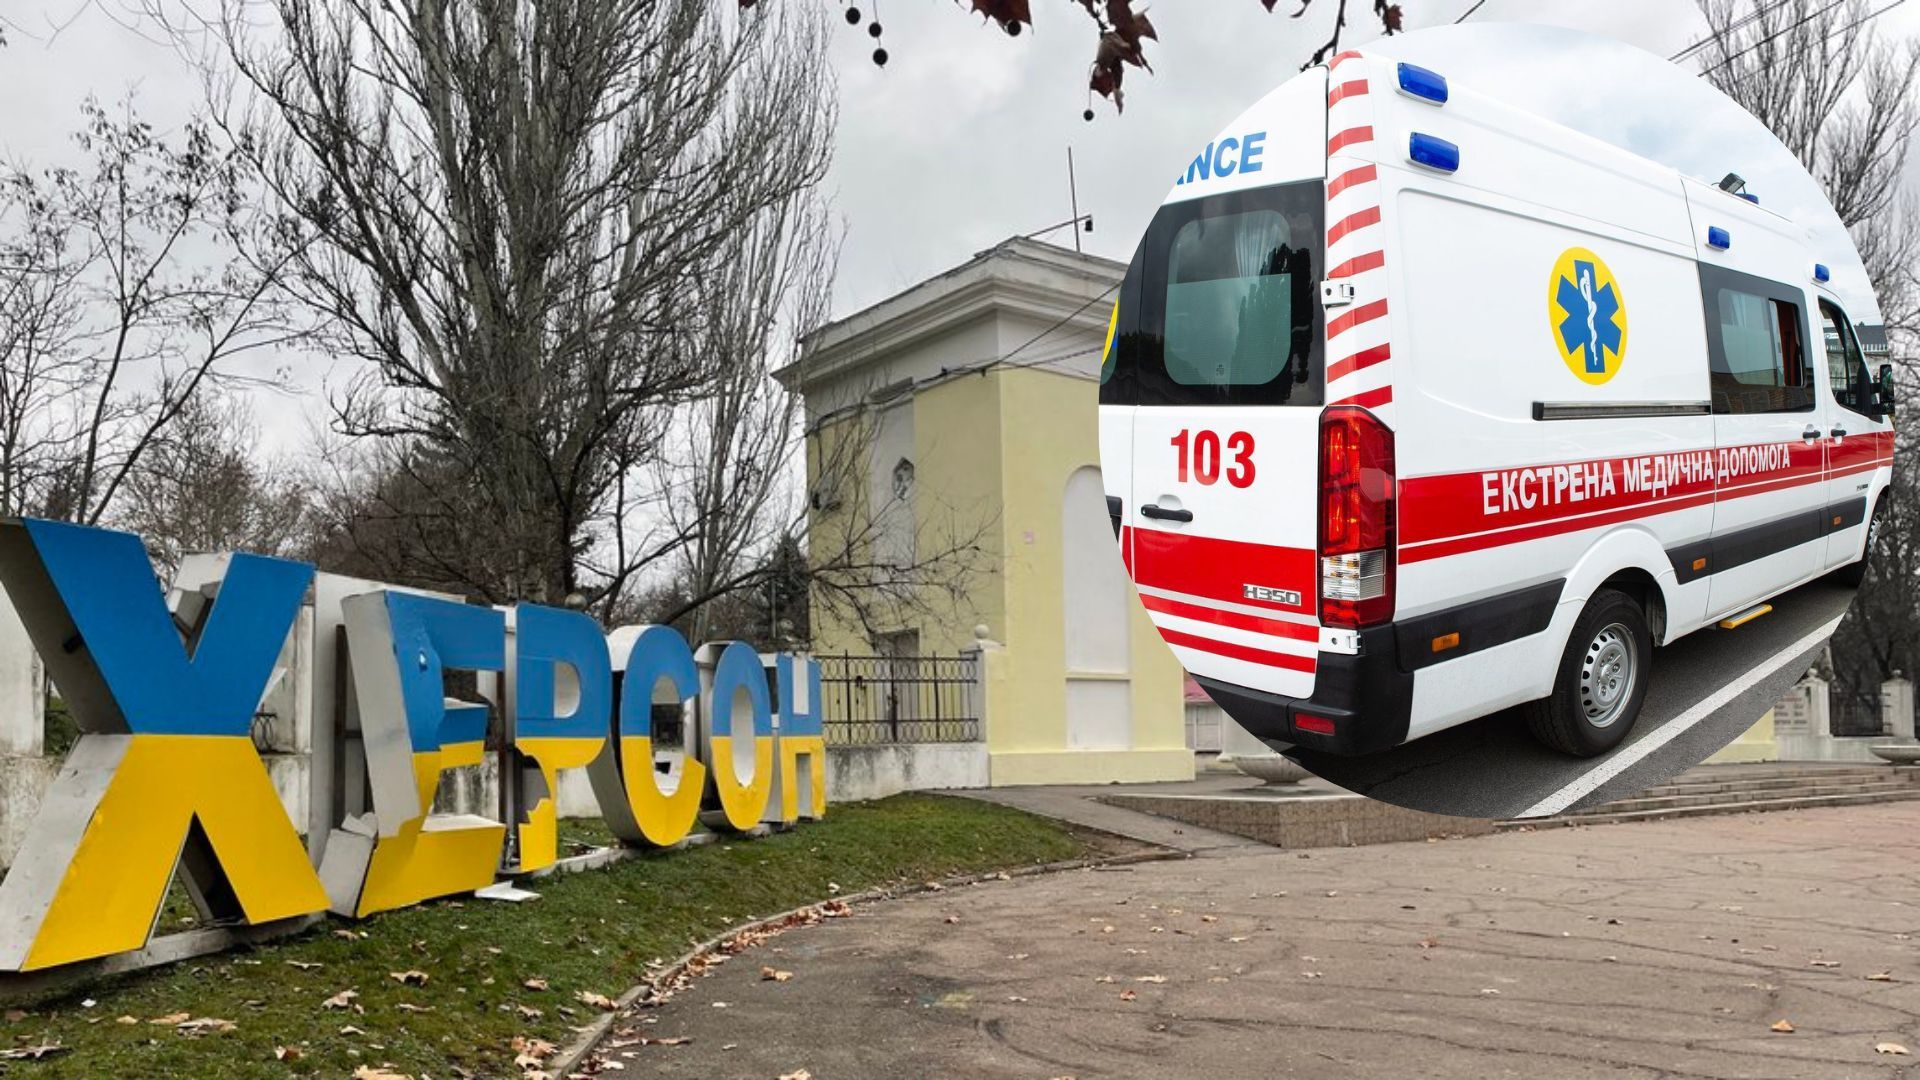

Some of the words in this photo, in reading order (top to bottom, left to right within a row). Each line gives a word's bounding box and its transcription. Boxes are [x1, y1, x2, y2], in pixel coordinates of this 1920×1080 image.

[1176, 131, 1267, 186] NCE
[1170, 428, 1256, 489] 103
[1482, 461, 1617, 516] ЕКСТРЕНА
[1622, 451, 1714, 498] МЕДИЧНА
[1717, 443, 1791, 485] ДОПОМОГА
[1243, 583, 1302, 607] H350
[0, 517, 826, 972] ХЕРСОН
